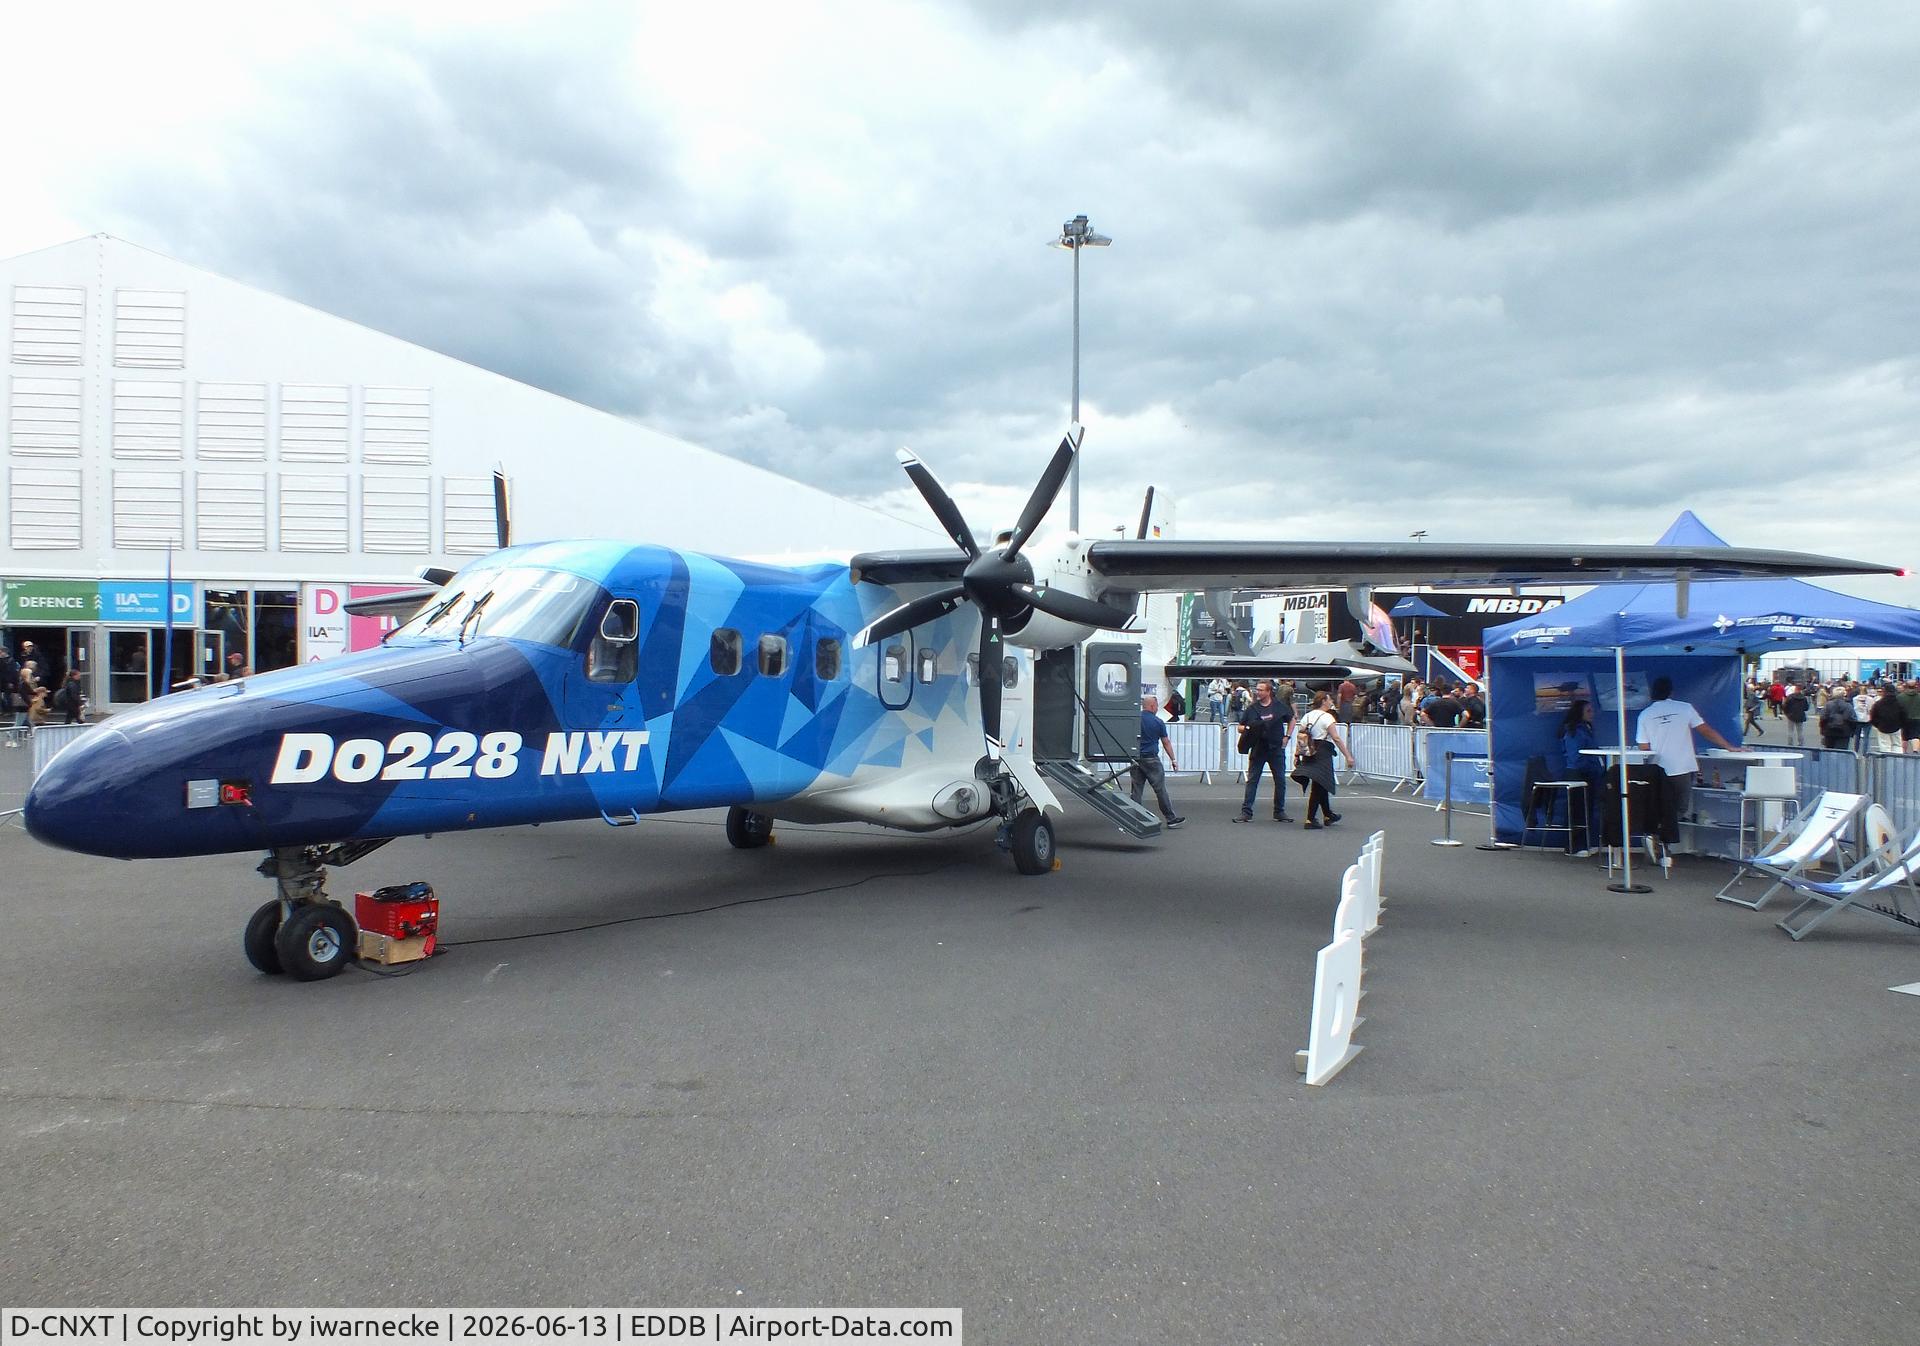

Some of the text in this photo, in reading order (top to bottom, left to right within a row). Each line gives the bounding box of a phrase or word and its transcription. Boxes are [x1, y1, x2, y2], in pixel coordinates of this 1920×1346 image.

[19, 596, 84, 609] DEFENCE
[172, 593, 191, 613] D
[315, 588, 339, 614] D
[1284, 595, 1327, 611] MBDA
[1736, 615, 1855, 630] GENERAL ATOMICS
[309, 626, 329, 638] ILA
[270, 730, 649, 784] Do228 NXT
